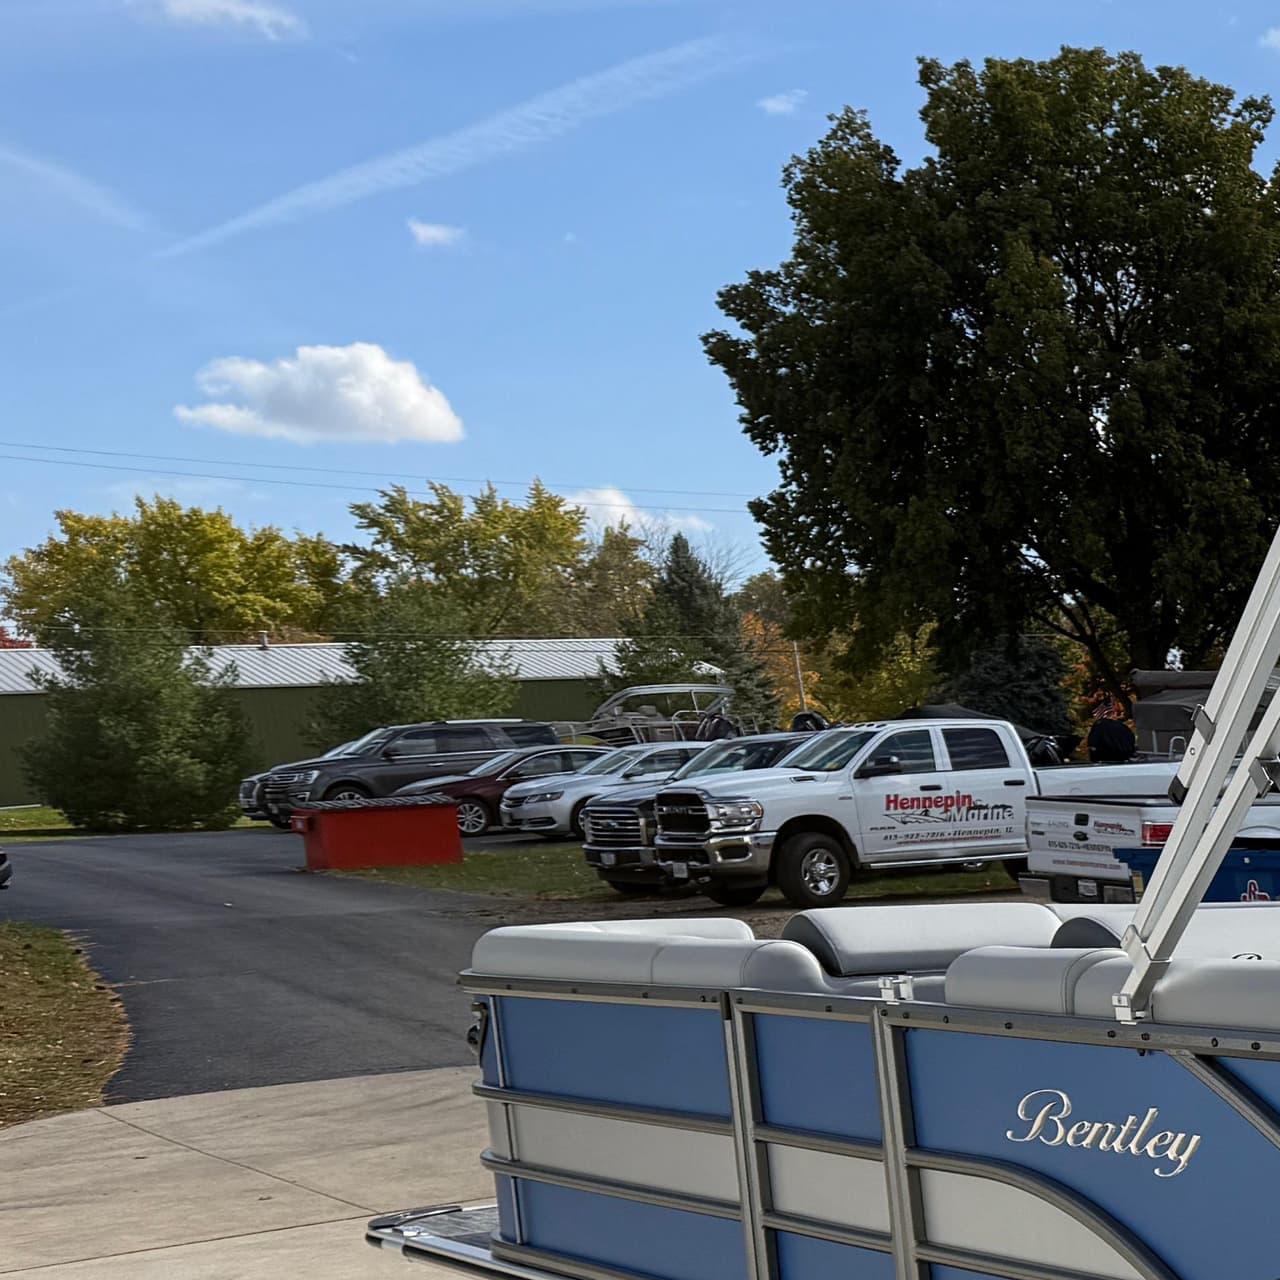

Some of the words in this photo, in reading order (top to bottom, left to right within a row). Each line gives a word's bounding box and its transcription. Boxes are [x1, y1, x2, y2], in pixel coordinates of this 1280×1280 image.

[885, 790, 973, 812] Hennepin
[947, 805, 1015, 823] Marine
[1006, 1088, 1201, 1178] Bentley
